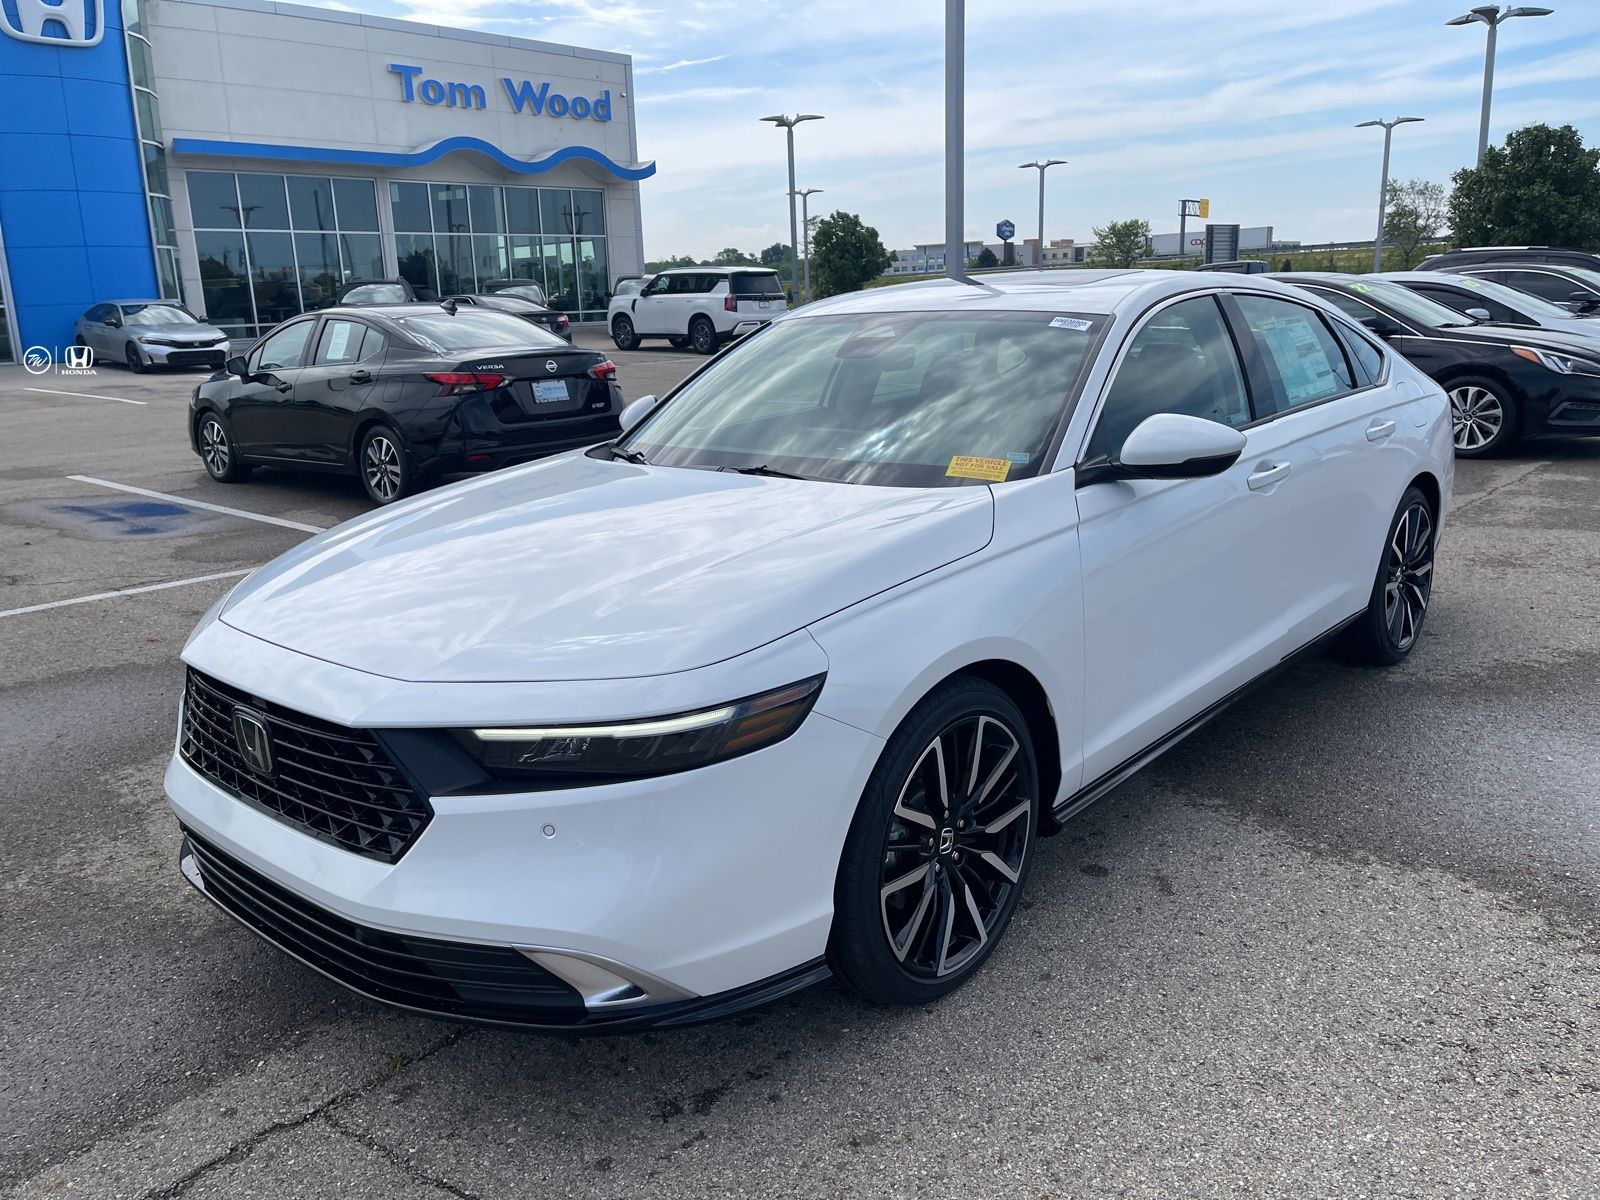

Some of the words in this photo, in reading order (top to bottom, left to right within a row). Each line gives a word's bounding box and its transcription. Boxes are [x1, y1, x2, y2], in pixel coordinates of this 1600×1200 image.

[387, 63, 487, 110] Tom
[500, 77, 612, 122] Wood
[975, 458, 1009, 467] VEHICLE
